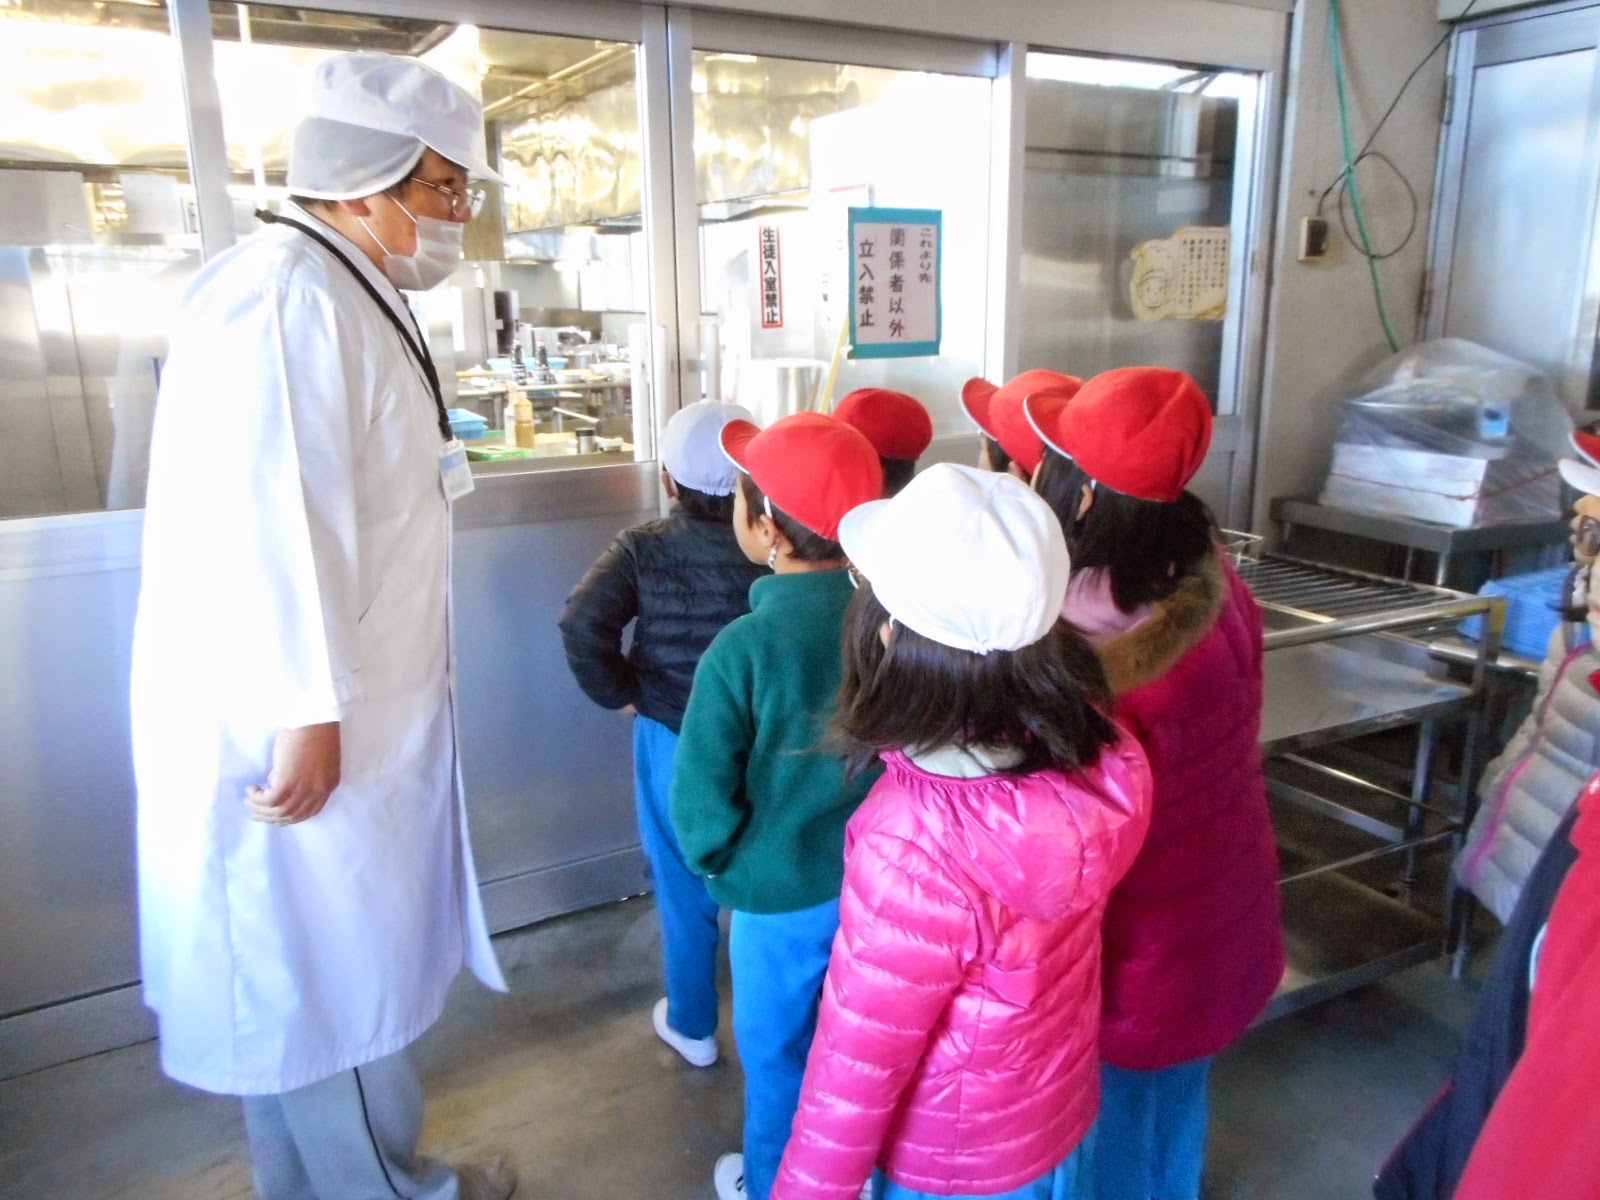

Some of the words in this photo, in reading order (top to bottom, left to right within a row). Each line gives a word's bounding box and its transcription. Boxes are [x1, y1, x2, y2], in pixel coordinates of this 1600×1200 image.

[763, 227, 778, 324] 生徒入室禁止
[859, 239, 875, 327] 立入禁止
[889, 227, 905, 337] 関係者以外
[919, 227, 932, 283] これより先
